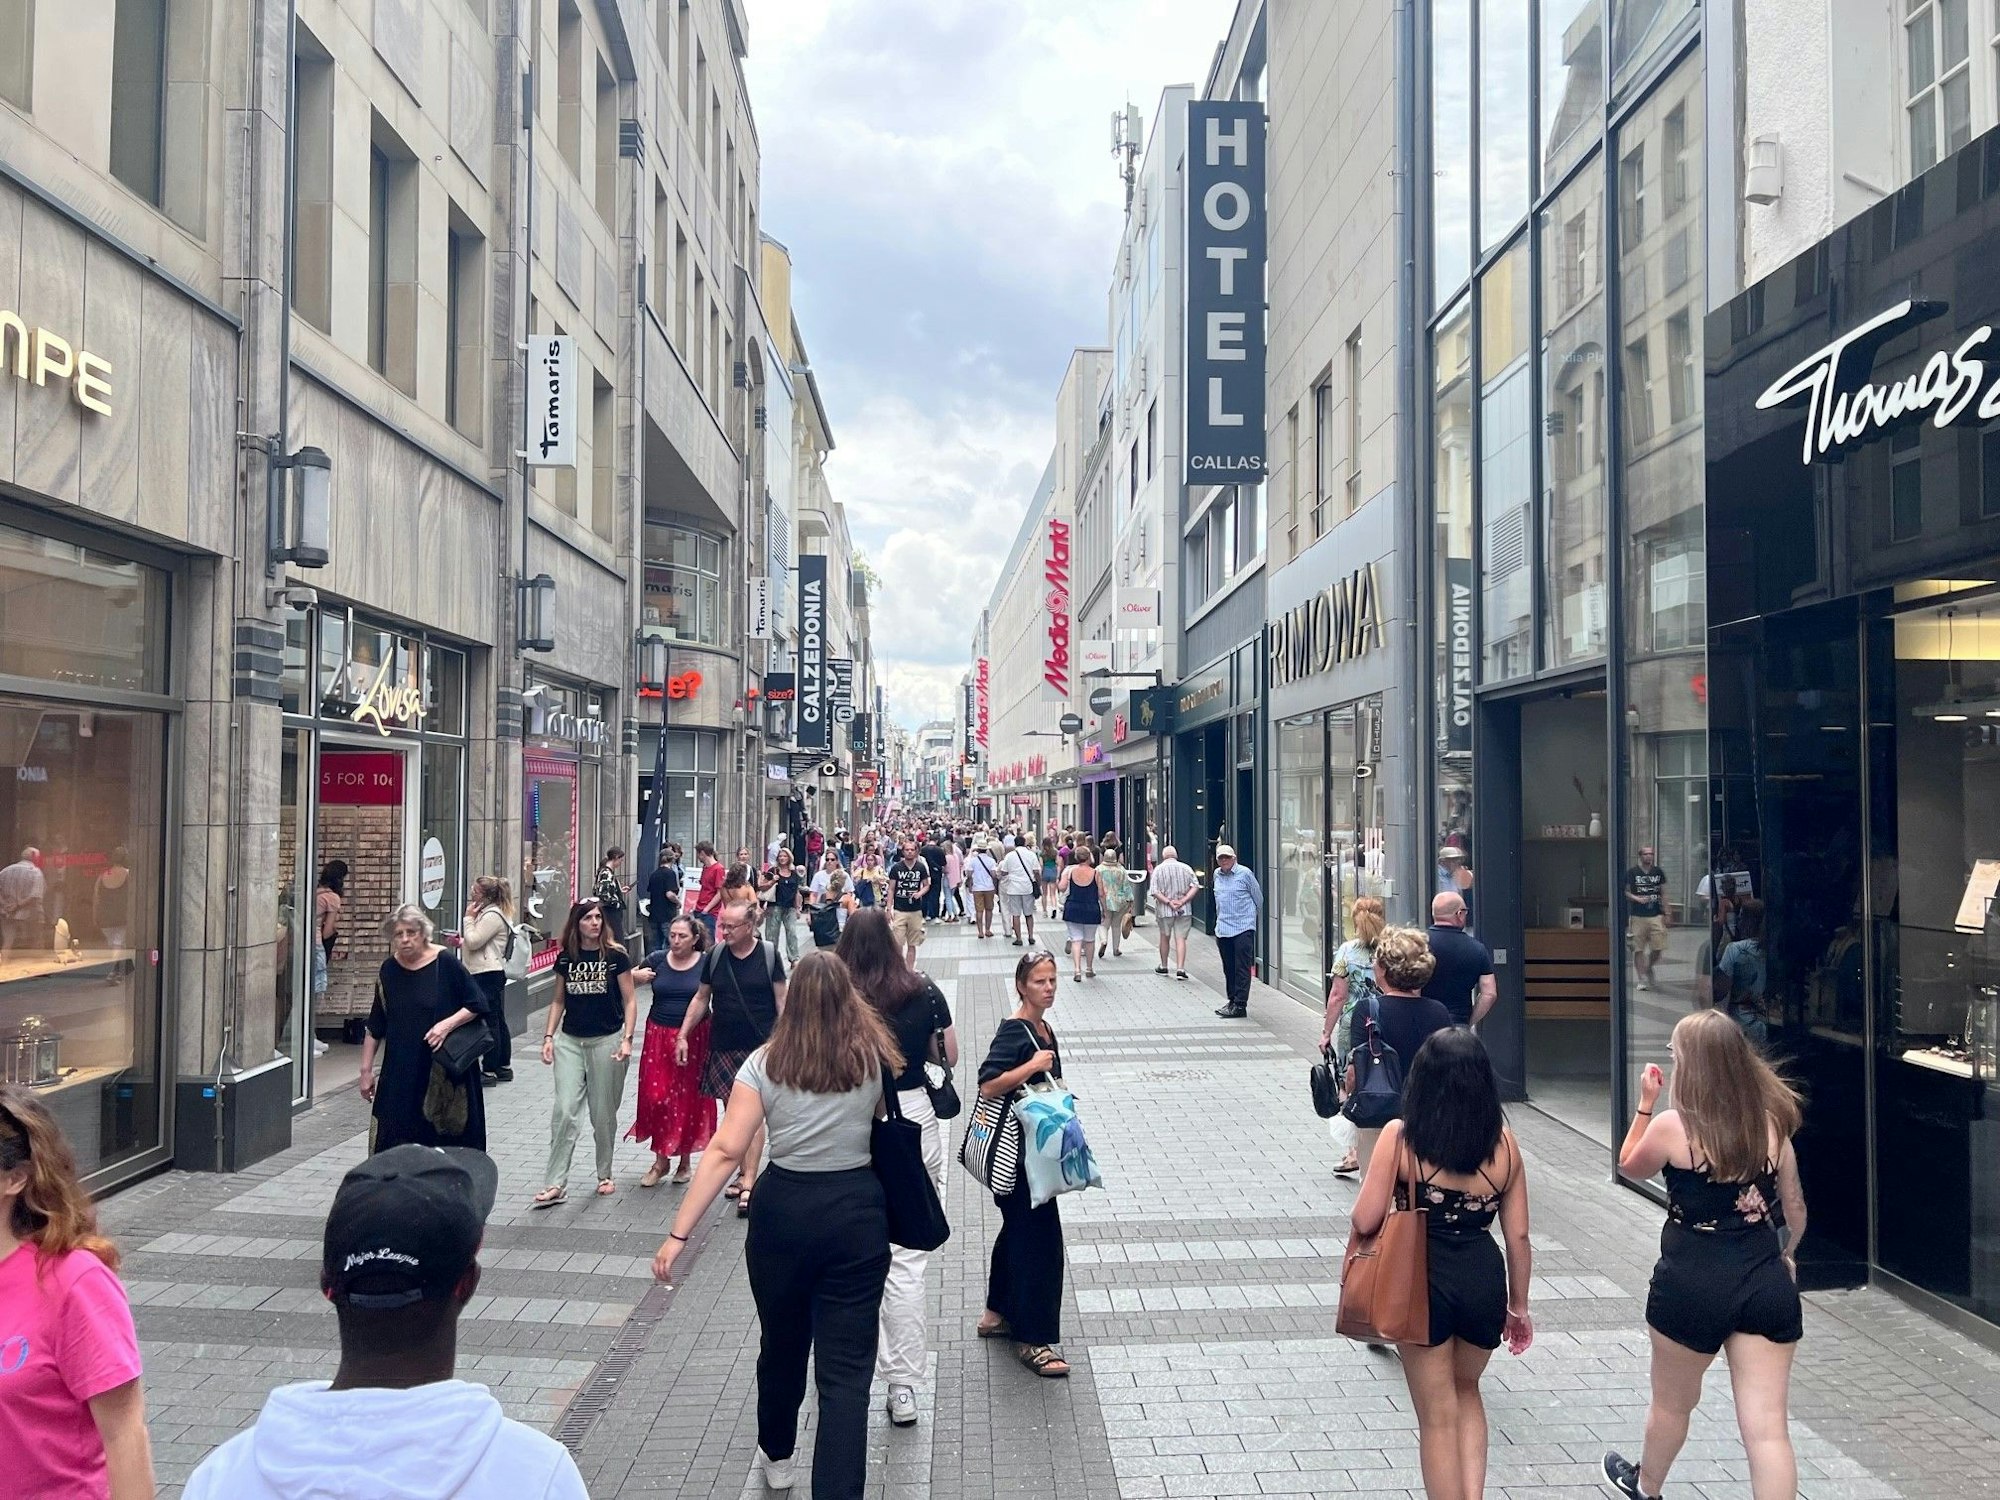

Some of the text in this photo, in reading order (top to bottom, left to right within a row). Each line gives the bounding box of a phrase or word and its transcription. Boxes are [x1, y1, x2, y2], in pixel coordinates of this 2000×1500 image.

[1203, 117, 1251, 427] HOTEL
[540, 340, 560, 460] Tamaris
[1755, 300, 1992, 465] Thomas
[1191, 455, 1261, 470] CALLAS
[645, 583, 693, 598] maris
[755, 579, 766, 636] Tamaris
[1270, 562, 1385, 689] RIMOWA
[803, 579, 821, 724] CALZEDONIA
[353, 646, 427, 737] Lovisa
[767, 688, 794, 700] size?
[322, 773, 331, 785] 5
[337, 773, 365, 786] FOR
[568, 961, 607, 973] LOVE
[568, 971, 607, 981] NEVER
[344, 1247, 420, 1272] Major League
